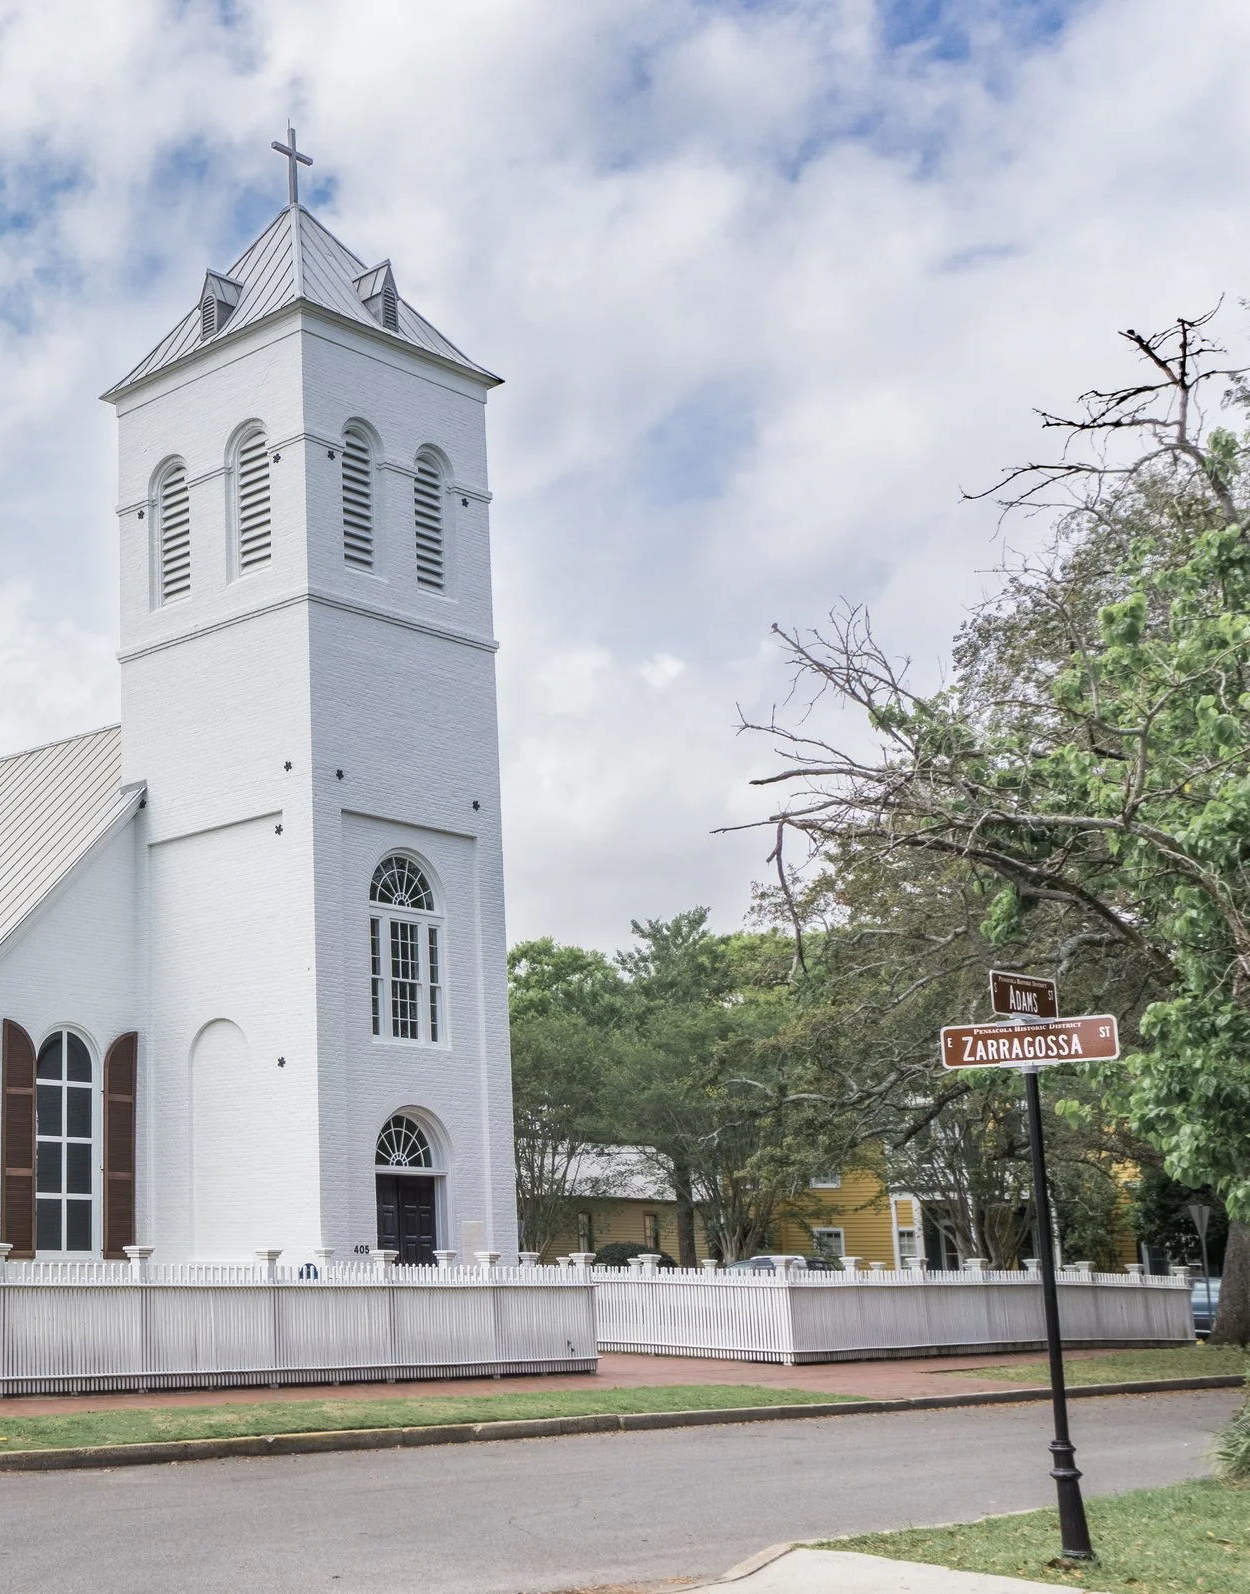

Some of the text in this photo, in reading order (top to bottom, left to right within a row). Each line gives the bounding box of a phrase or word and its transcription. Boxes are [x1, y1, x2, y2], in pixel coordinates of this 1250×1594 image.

[1009, 985, 1038, 1013] ADAMS
[973, 1027, 1012, 1035] PENSACOLA
[1049, 1022, 1082, 1030] DISTRICT
[1099, 1026, 1110, 1038] ST
[947, 1038, 953, 1048] E
[961, 1033, 1083, 1062] ZARRAGOSSA
[353, 1245, 370, 1255] 405
